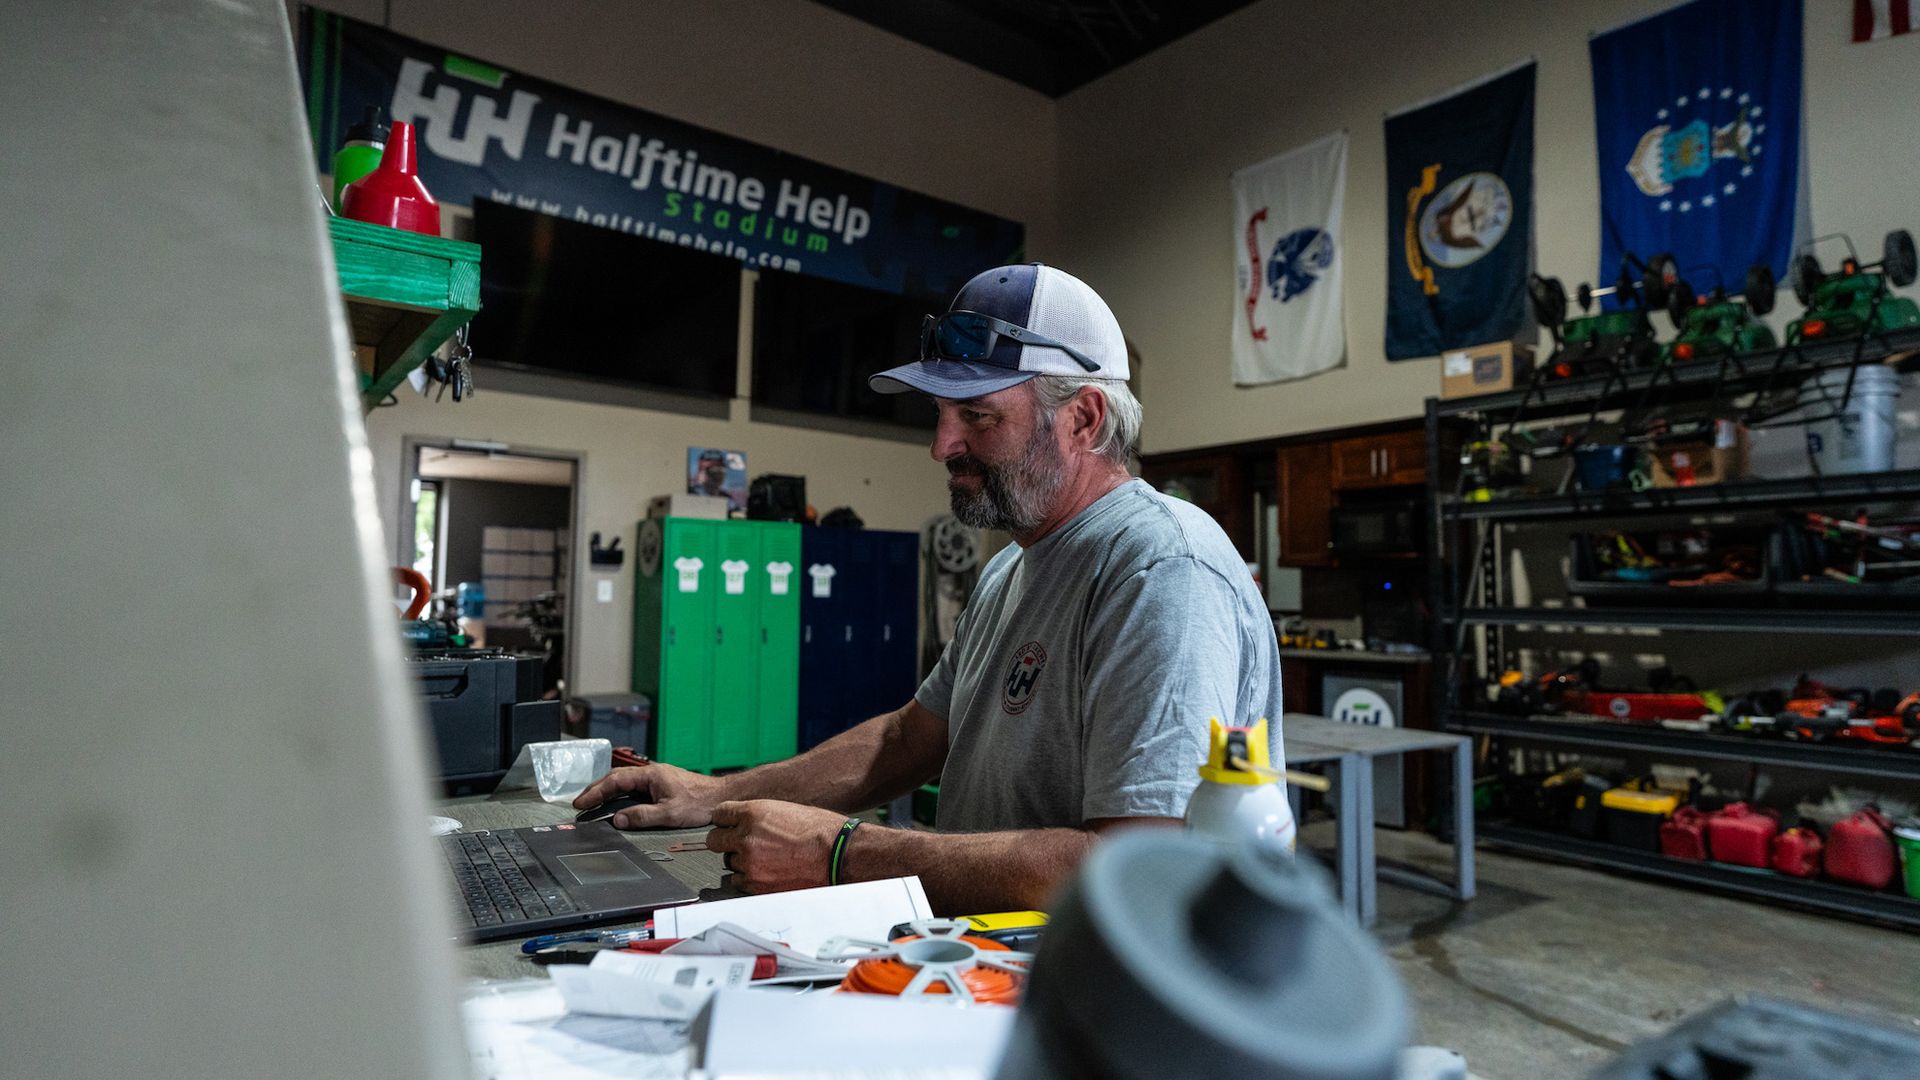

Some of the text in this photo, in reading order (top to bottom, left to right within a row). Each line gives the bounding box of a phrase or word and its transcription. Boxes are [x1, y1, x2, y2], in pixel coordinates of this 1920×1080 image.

[546, 112, 871, 245] Halftime Help
[663, 192, 830, 253] Stadium
